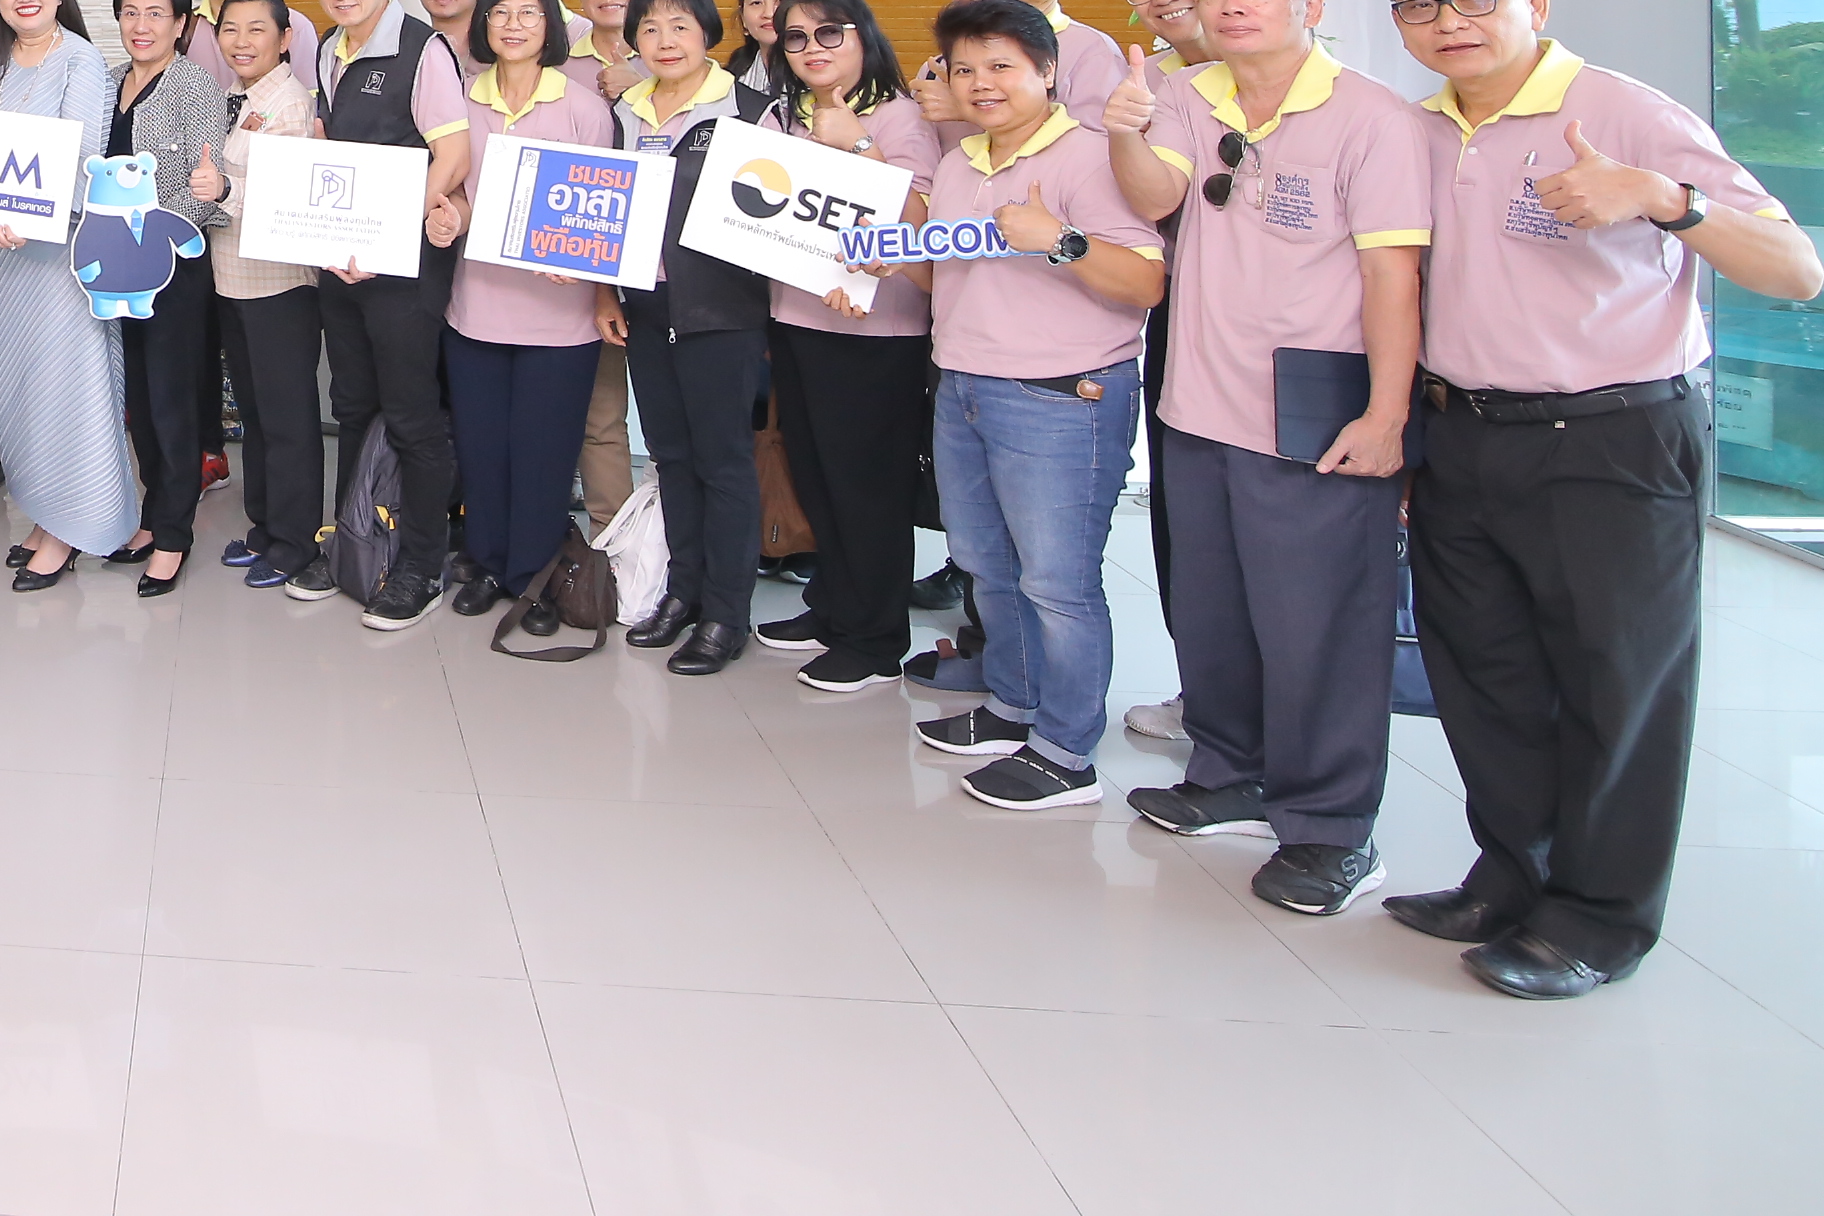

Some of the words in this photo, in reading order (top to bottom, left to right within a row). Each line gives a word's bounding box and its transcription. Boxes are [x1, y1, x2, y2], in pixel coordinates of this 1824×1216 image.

[567, 164, 632, 189] ชมรม
[11, 197, 52, 214] โบรคเกอร์
[547, 183, 628, 220] อาสา
[793, 188, 876, 232] SET
[561, 213, 624, 235] พิทักษ์สิทธิ
[723, 215, 837, 263] ตลาดหลักทรัพย์แห่งประเท
[841, 221, 1008, 259] WELCOM
[531, 224, 620, 267] ผู้ถือหุ้น
